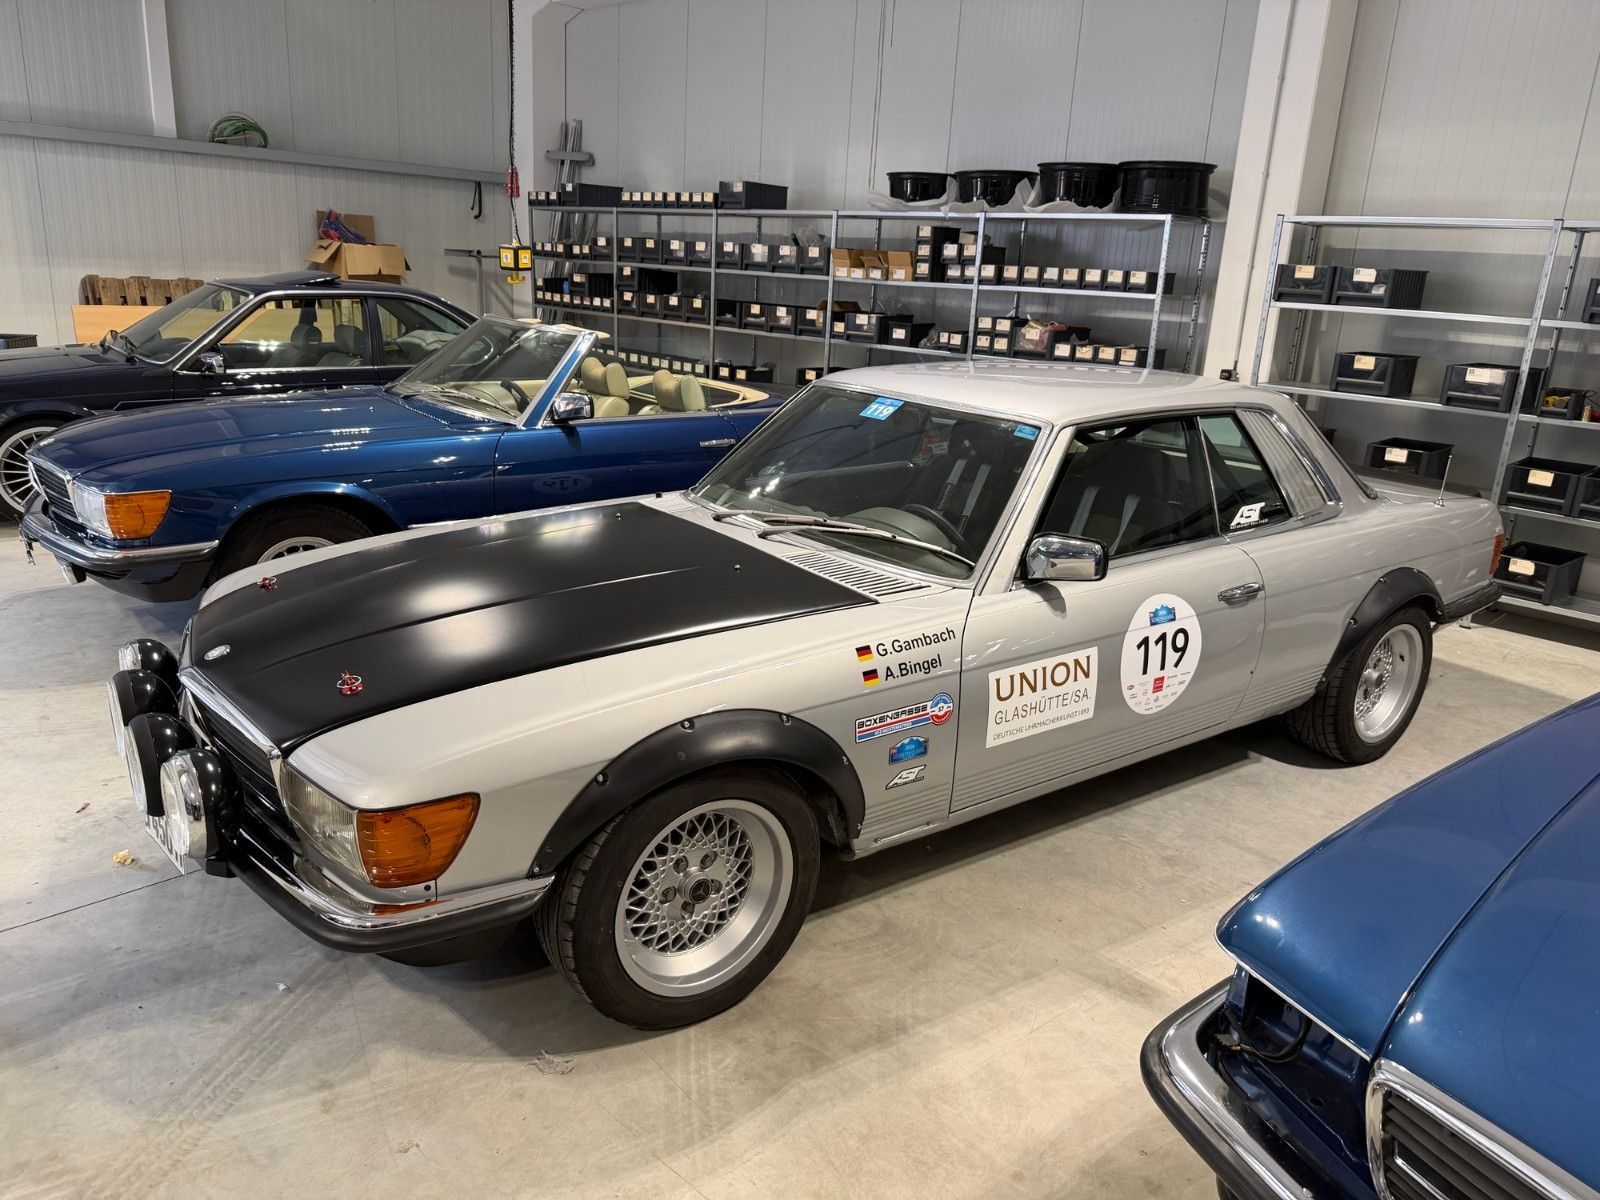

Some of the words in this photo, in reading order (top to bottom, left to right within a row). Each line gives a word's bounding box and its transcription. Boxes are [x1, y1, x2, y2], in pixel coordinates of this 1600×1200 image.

[866, 404, 893, 417] 119
[876, 627, 956, 657] G.Gambach
[1136, 627, 1190, 676] 119
[885, 653, 943, 682] A.Bingel
[995, 654, 1092, 702] UNION
[857, 704, 928, 730] BOXENGASSE
[994, 687, 1092, 726] GLASHÜTTE/SA.
[992, 725, 1024, 741] DEUTSCHE
